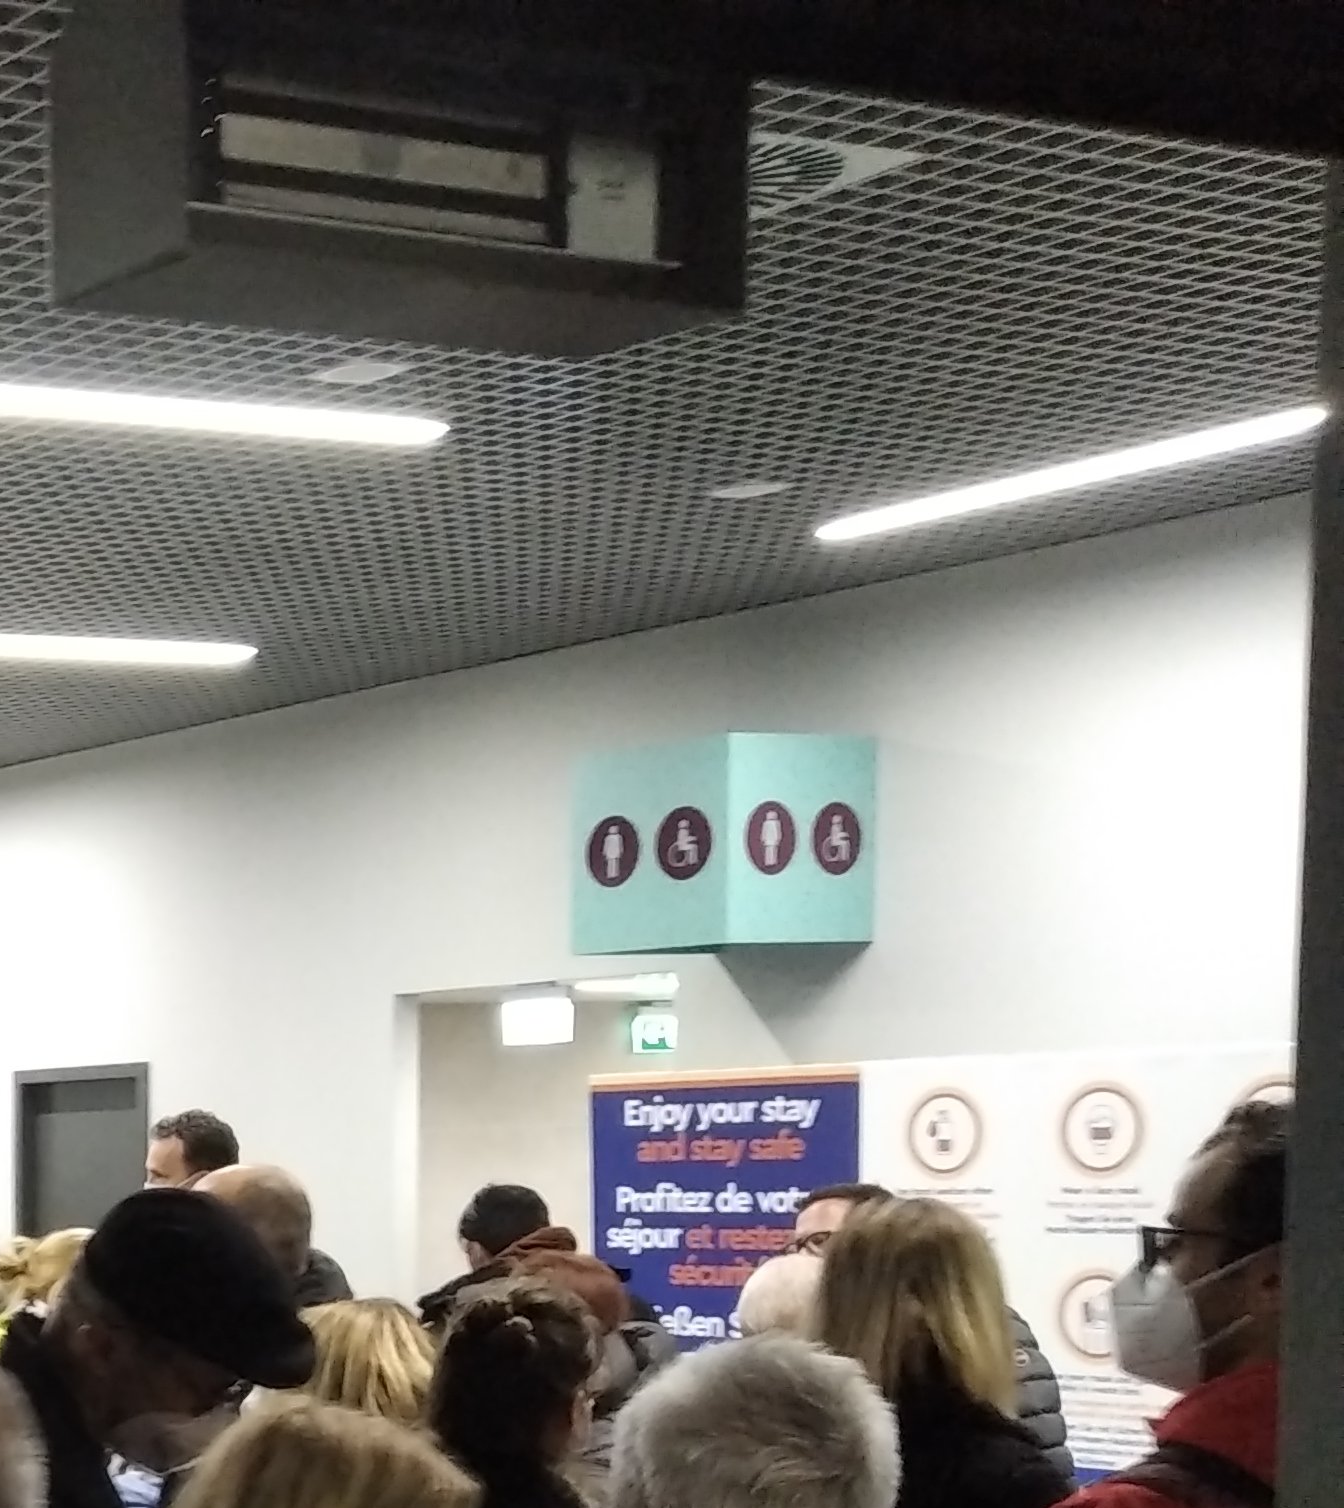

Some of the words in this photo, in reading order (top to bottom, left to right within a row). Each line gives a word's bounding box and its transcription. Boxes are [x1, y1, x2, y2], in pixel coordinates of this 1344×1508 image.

[623, 1095, 694, 1132] Enjoy
[695, 1099, 759, 1131] your
[760, 1095, 822, 1129] stay
[637, 1131, 687, 1163] and
[689, 1135, 746, 1168] stay
[749, 1128, 807, 1161] safe
[615, 1182, 713, 1213] Profitez
[715, 1181, 753, 1213] de
[606, 1217, 684, 1256] séjour
[685, 1224, 714, 1250] et
